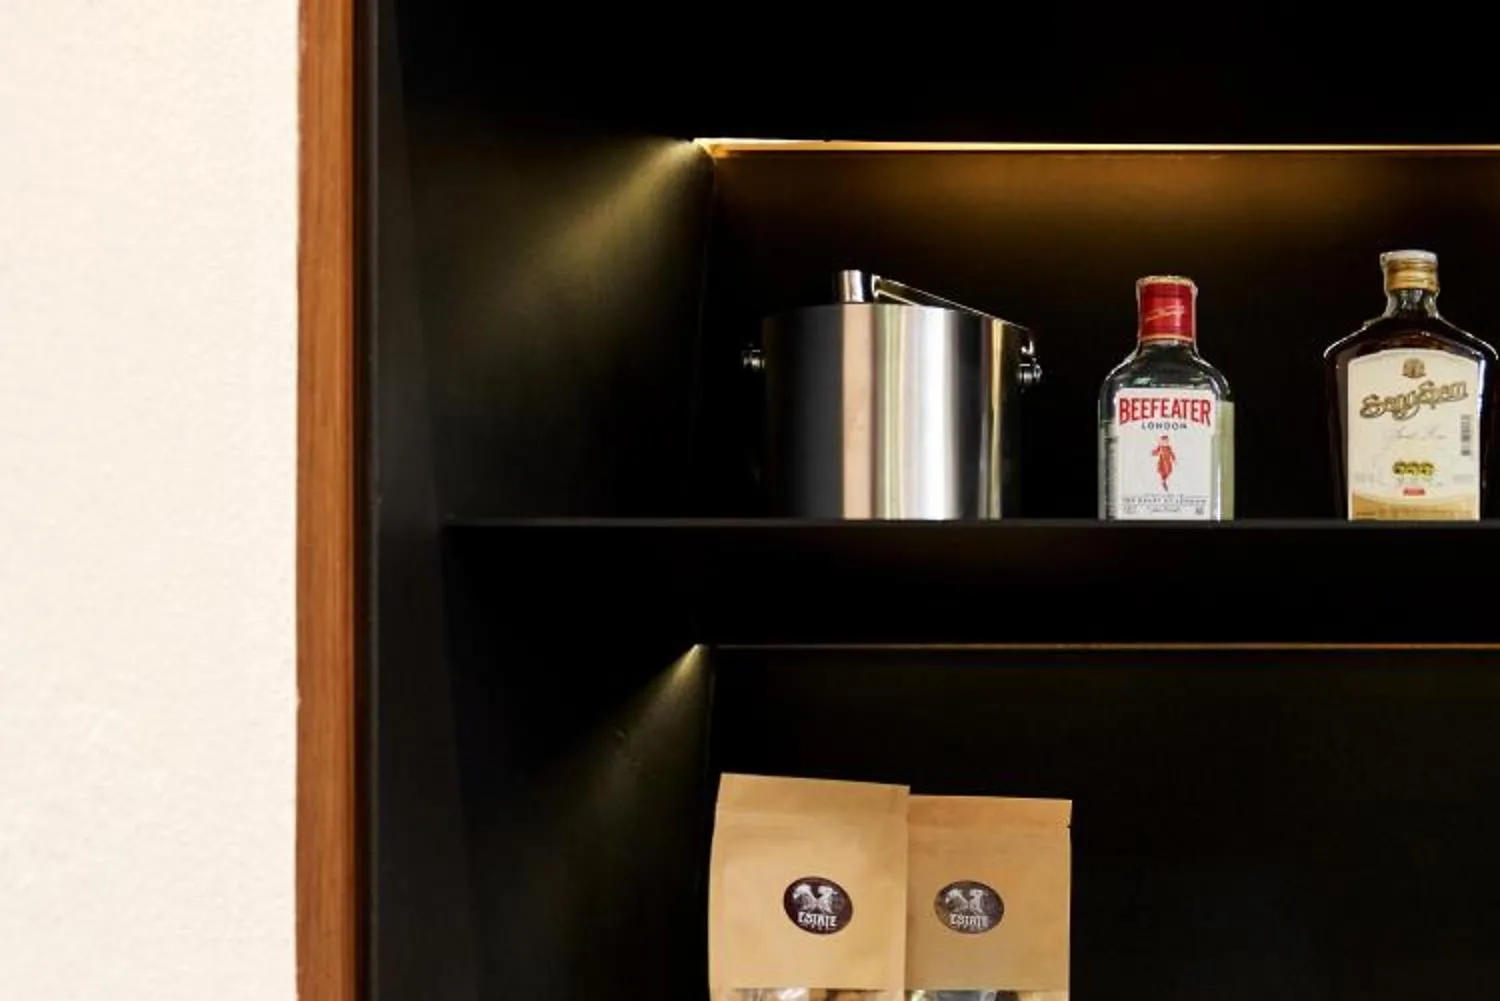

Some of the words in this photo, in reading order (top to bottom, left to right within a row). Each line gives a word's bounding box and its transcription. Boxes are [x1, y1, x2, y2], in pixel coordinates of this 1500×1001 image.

[1119, 398, 1211, 427] BEEFEATER
[1141, 421, 1187, 431] LONDON
[798, 911, 837, 927] ESTATE
[949, 913, 988, 927] ESTATE
